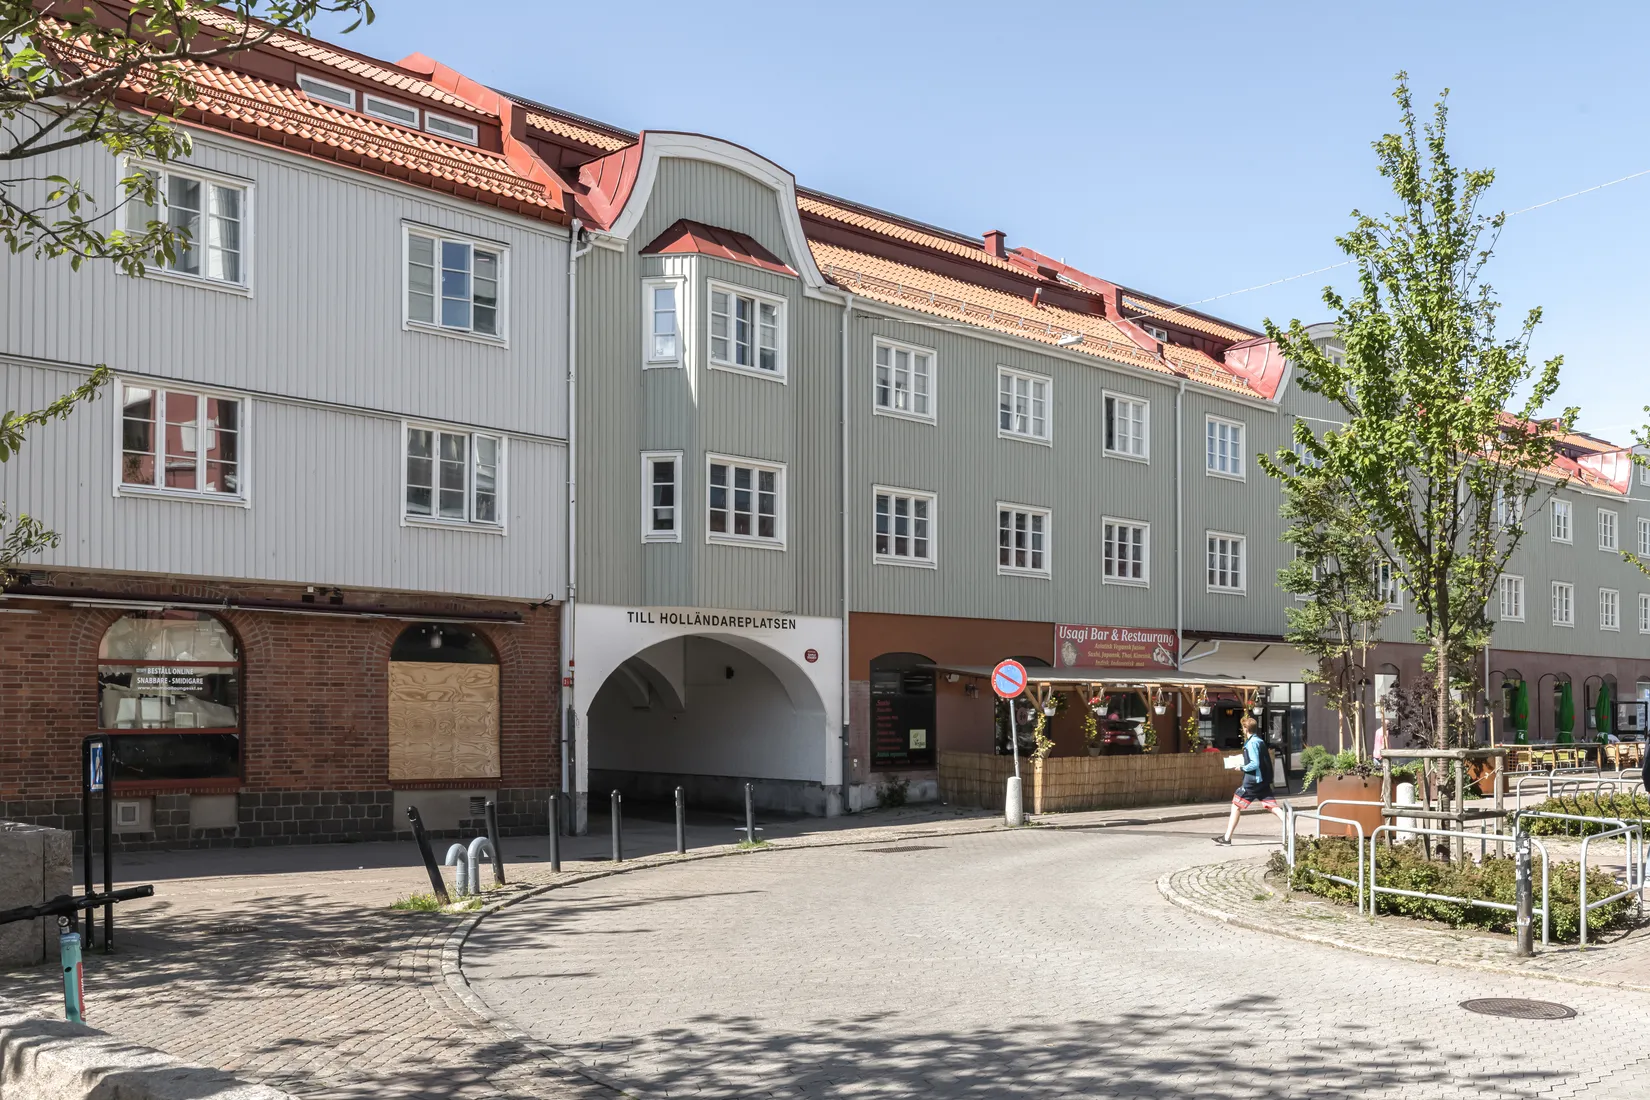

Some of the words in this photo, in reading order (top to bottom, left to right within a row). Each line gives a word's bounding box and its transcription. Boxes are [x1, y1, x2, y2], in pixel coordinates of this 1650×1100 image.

[627, 611, 655, 624] TILL
[660, 611, 796, 630] HOLLÄNDAREPLATSEN
[1059, 626, 1088, 643] Usagi
[1090, 627, 1109, 641] Bar
[1111, 628, 1119, 641] &
[1121, 629, 1174, 646] Restaurang
[147, 666, 172, 675] BESTÄLL
